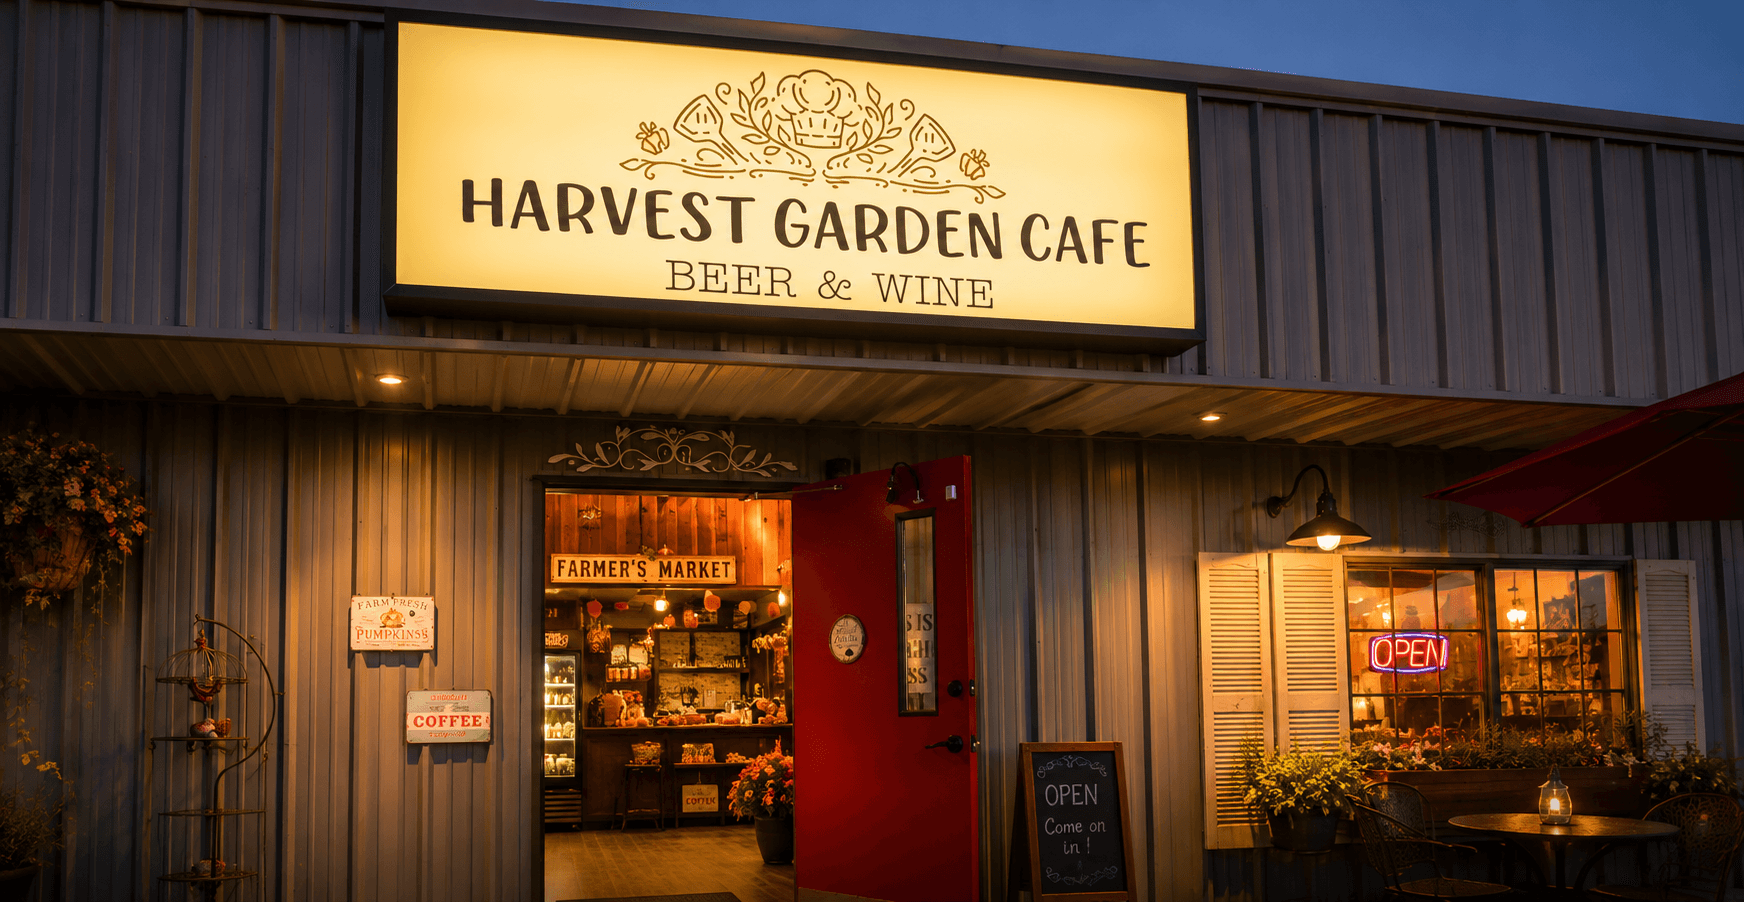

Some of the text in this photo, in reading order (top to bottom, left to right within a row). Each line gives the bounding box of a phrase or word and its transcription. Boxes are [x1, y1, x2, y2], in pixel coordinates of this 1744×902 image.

[462, 178, 1151, 268] HARVEST GARDEN CAFE
[665, 260, 994, 309] BEER & WINE
[557, 559, 731, 578] FARMER'S MARKET
[358, 598, 390, 611] FARM
[1374, 638, 1446, 667] OPEN
[413, 715, 482, 728] COFFEE
[1044, 783, 1098, 806] OPEN
[1044, 817, 1107, 835] Come on
[1063, 840, 1080, 854] in
